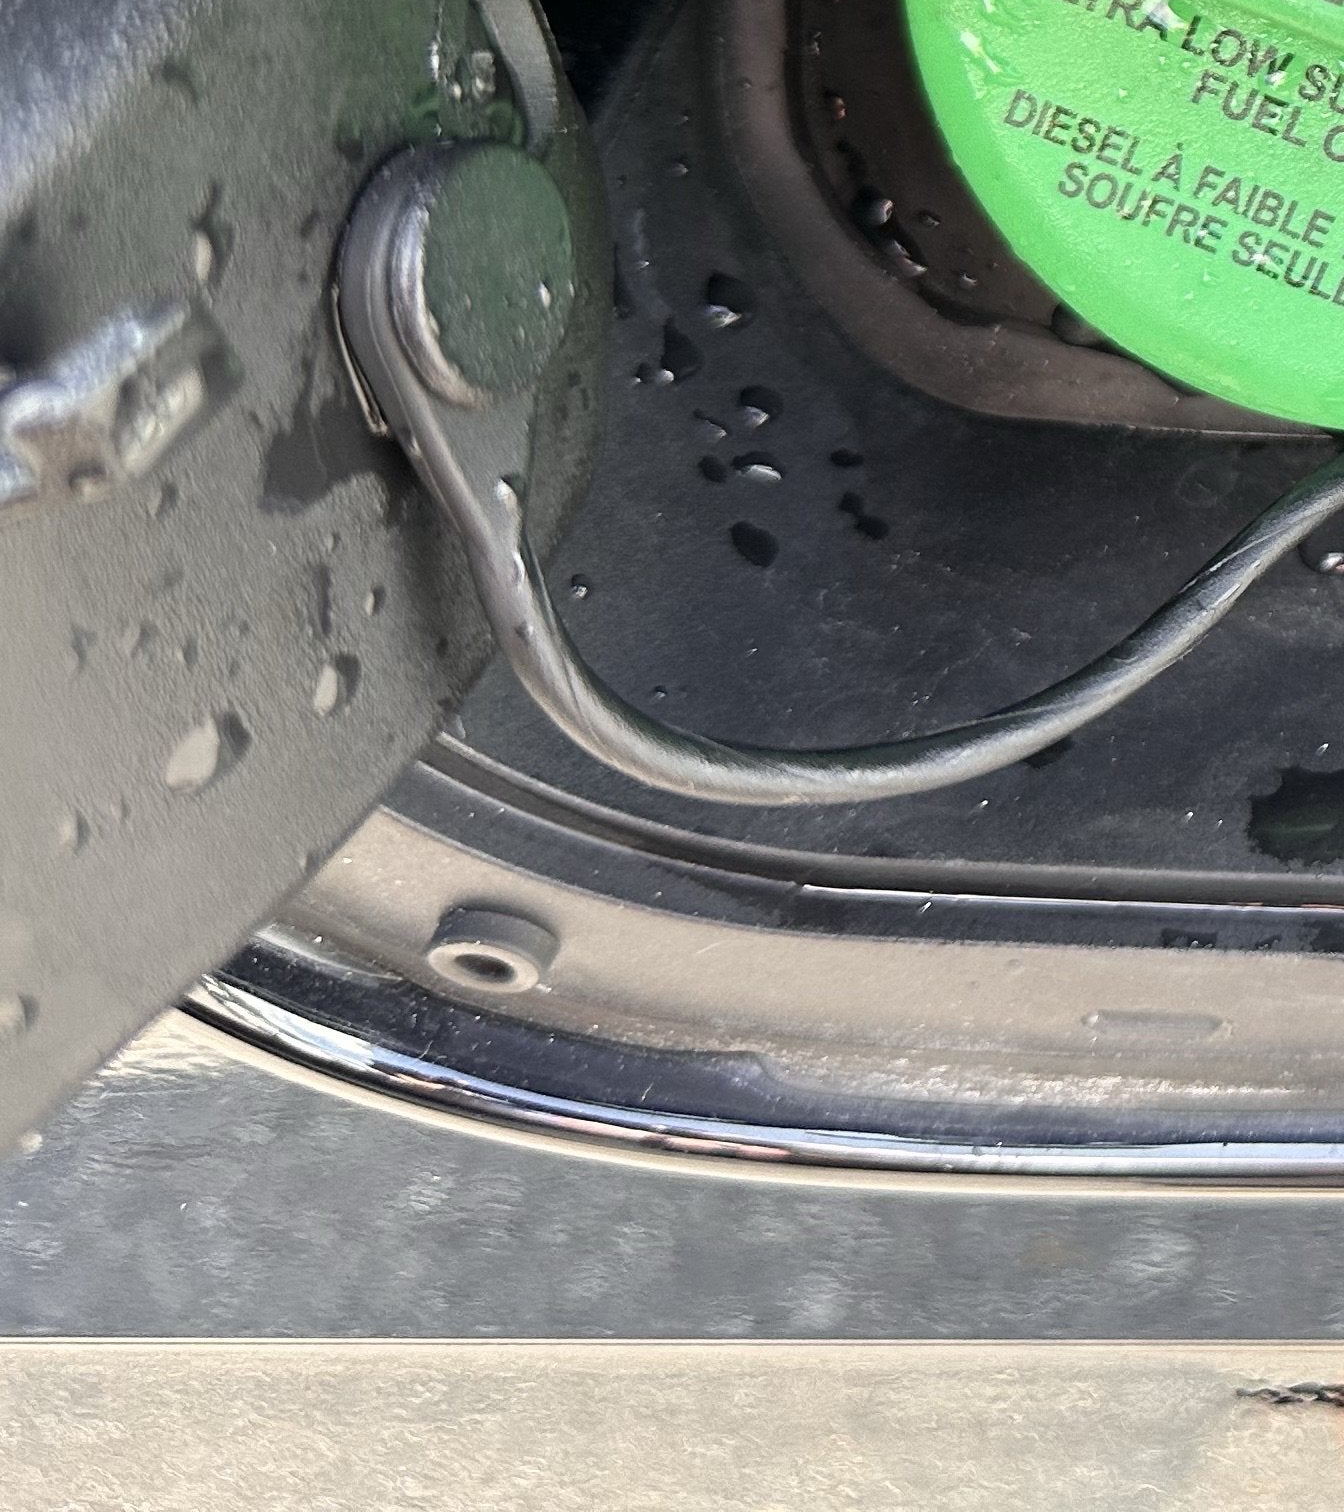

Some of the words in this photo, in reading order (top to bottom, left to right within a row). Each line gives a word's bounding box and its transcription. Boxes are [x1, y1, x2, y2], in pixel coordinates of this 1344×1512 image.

[1180, 15, 1295, 86] LOW
[1190, 69, 1307, 147] FUEL
[1004, 89, 1147, 178] DIESEL
[1193, 164, 1334, 247] FAIBLE
[1058, 161, 1223, 252] SOUFRE
